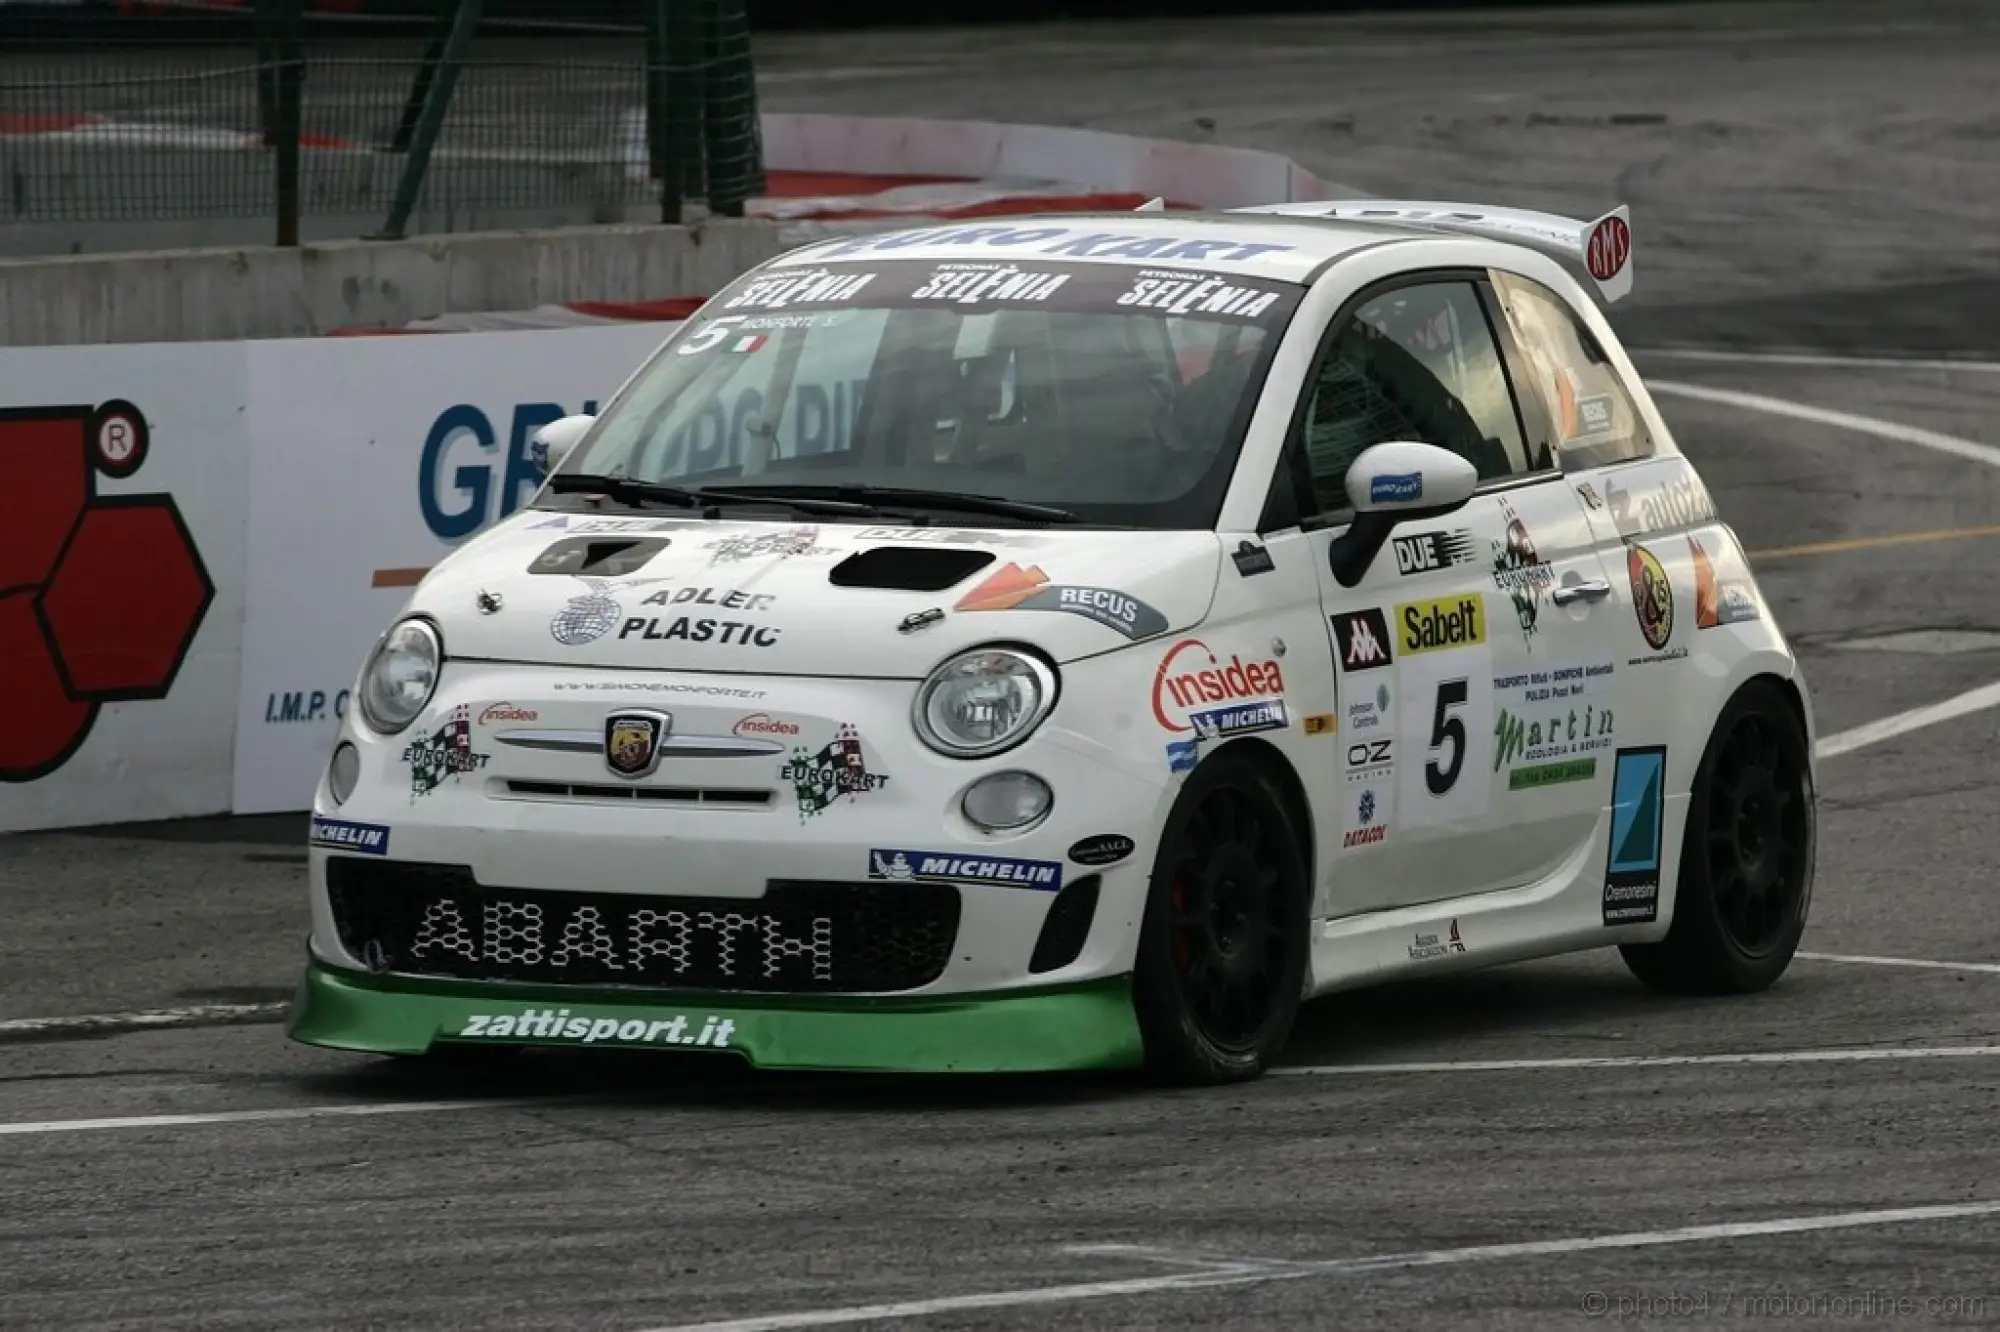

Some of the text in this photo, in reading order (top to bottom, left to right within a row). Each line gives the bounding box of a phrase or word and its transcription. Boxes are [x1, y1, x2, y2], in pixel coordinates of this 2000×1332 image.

[1040, 233, 1298, 262] KART
[677, 314, 749, 355] 5
[1394, 535, 1439, 573] DUE
[641, 587, 777, 611] ADLER
[1060, 588, 1138, 623] RECUS
[617, 616, 782, 648] PLASTIC
[1404, 599, 1478, 651] Sabelt
[1164, 654, 1286, 708] insidea
[264, 689, 327, 723] I.M.P.
[1221, 705, 1283, 730] MICHELIN
[740, 718, 801, 736] insidea
[1424, 675, 1469, 799] 5
[1493, 704, 1614, 774] Martin
[919, 857, 1056, 884] MICHELIN
[410, 898, 832, 981] ABARTH
[460, 1007, 736, 1049] zattisport.it
